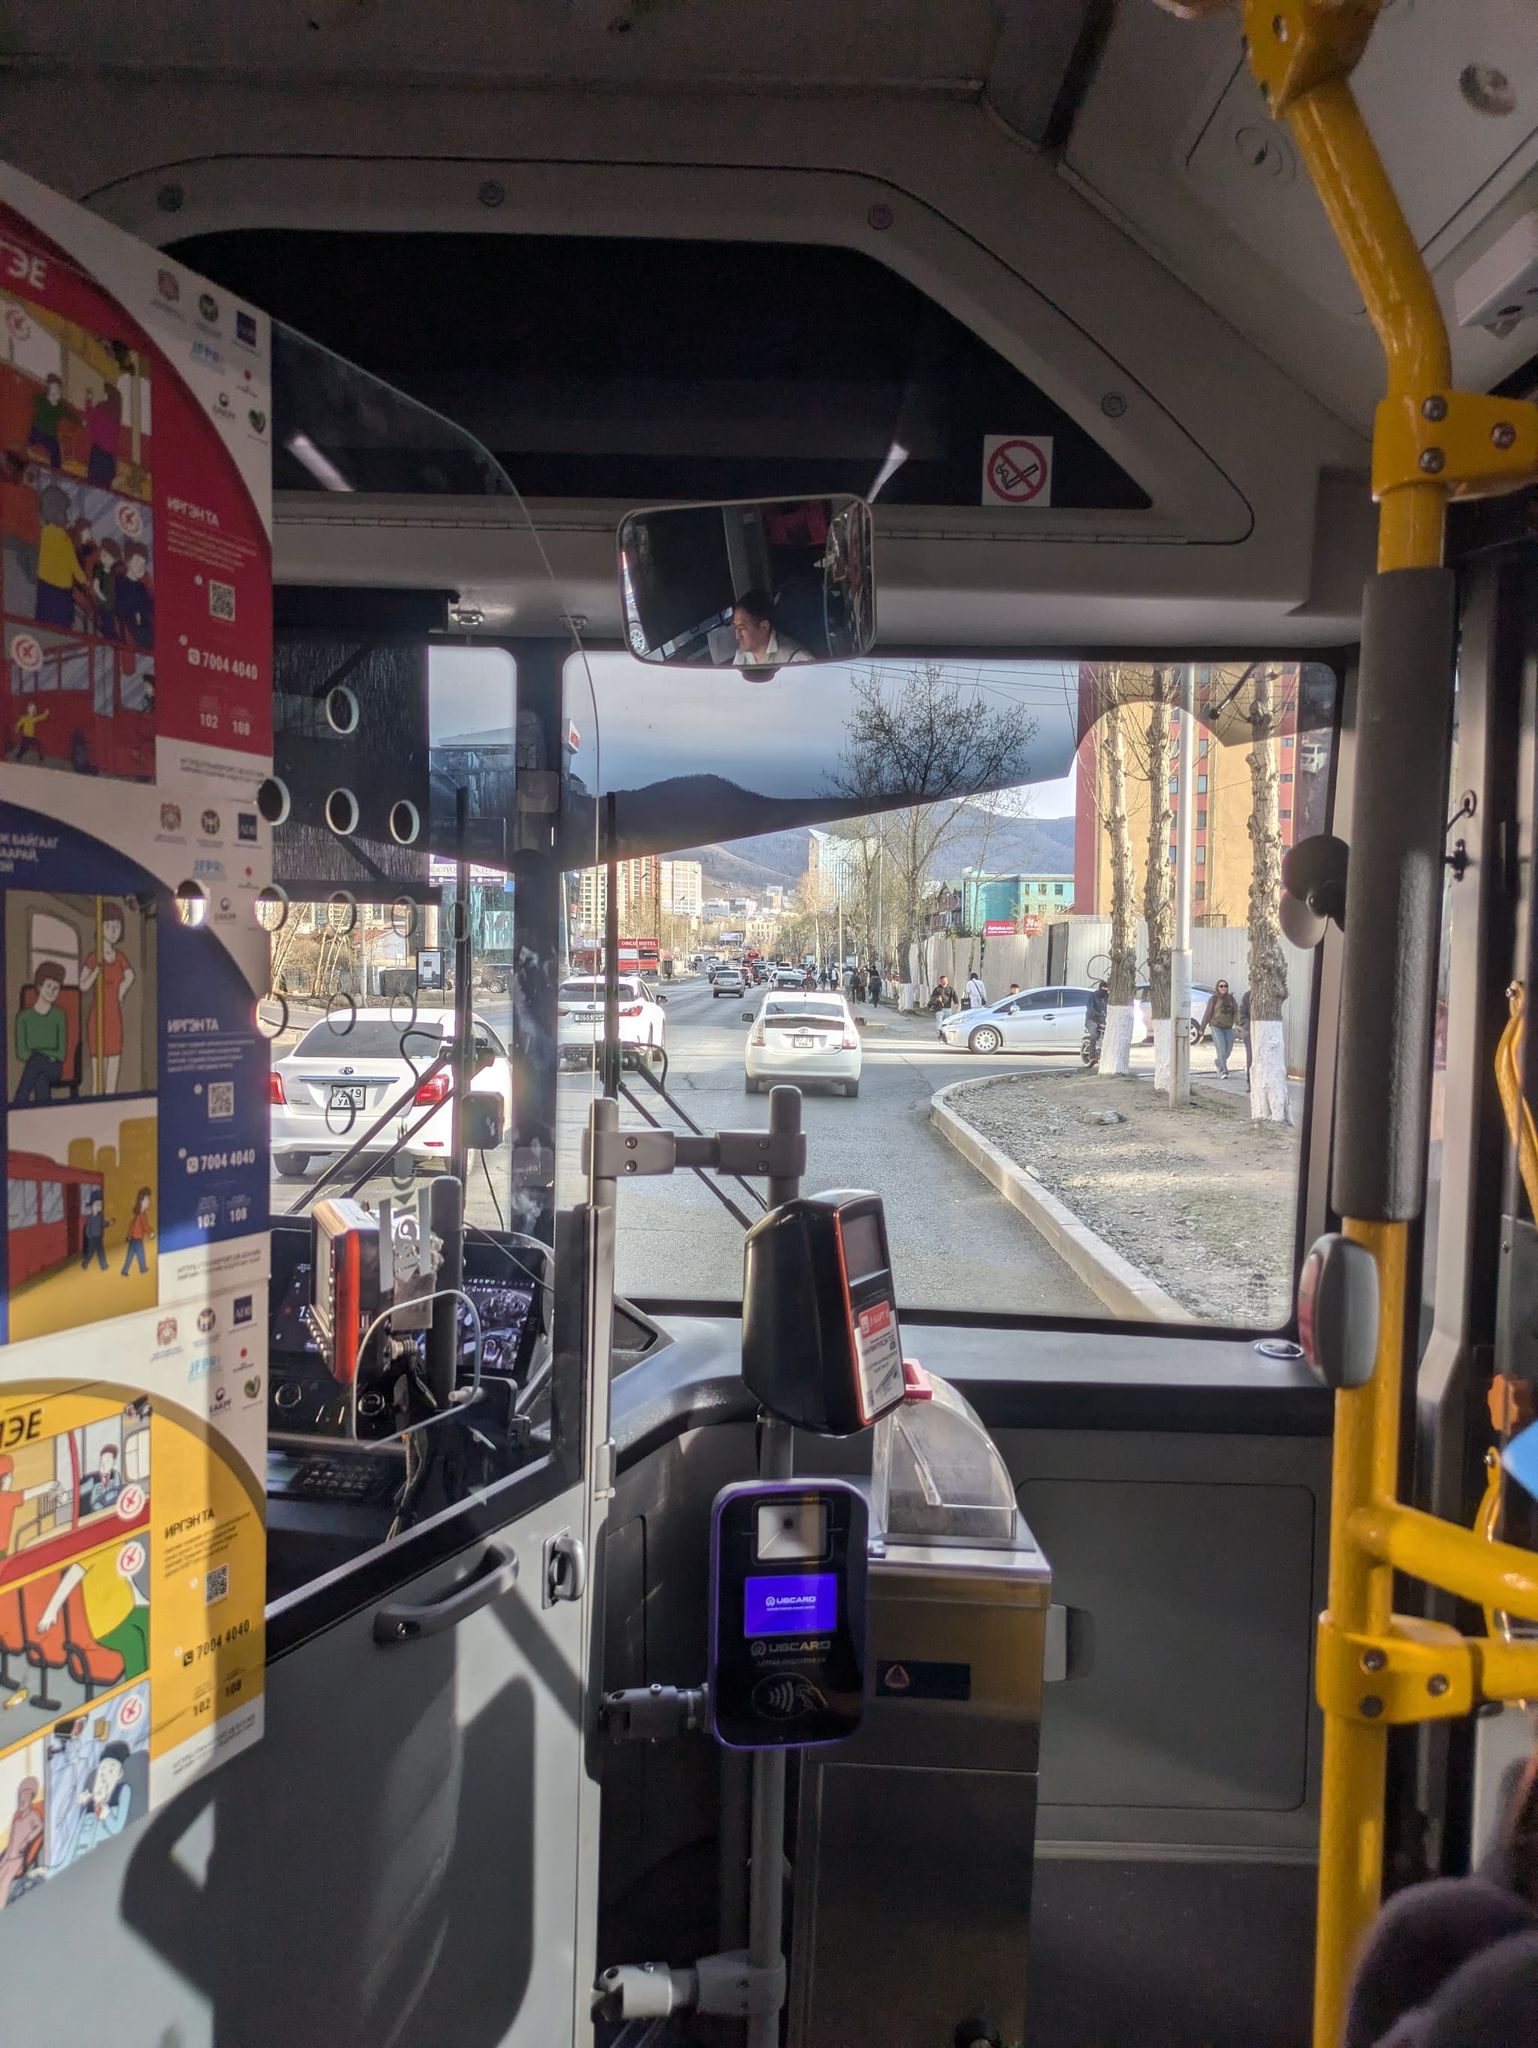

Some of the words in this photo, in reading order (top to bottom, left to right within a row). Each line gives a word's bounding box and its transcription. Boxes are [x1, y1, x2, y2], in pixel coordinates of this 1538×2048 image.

[167, 497, 203, 520] ИРГЭН
[203, 652, 229, 672] 7004
[232, 659, 258, 680] 4040
[200, 713, 218, 729] 102
[167, 1018, 203, 1034] ИРГЭН
[204, 1018, 219, 1031] ТА
[201, 1154, 227, 1171] 7004
[230, 1148, 255, 1167] 4040
[197, 1212, 216, 1228] 102
[165, 1513, 200, 1539] ИРГЭН
[201, 1508, 215, 1522] ТА
[776, 1595, 817, 1605] UBCARD
[196, 1634, 222, 1660] 7004
[225, 1619, 249, 1642] 4040
[768, 1641, 831, 1653] UBCARD
[193, 1697, 211, 1716] 102
